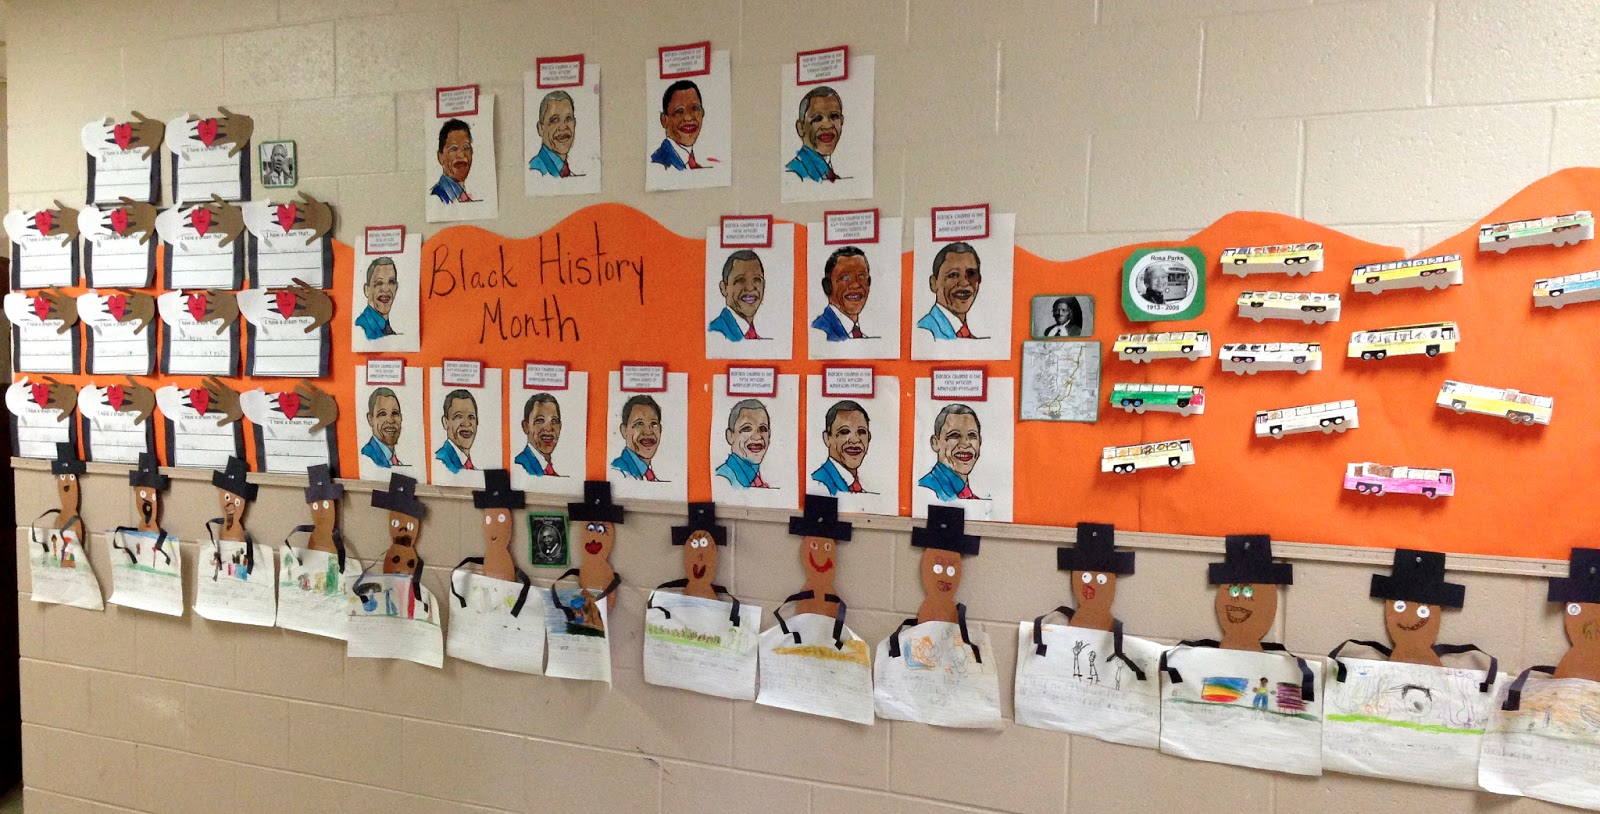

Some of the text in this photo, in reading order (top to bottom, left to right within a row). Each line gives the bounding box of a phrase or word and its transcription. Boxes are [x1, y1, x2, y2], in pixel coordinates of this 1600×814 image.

[429, 221, 644, 305] Black History
[479, 294, 580, 344] Month
